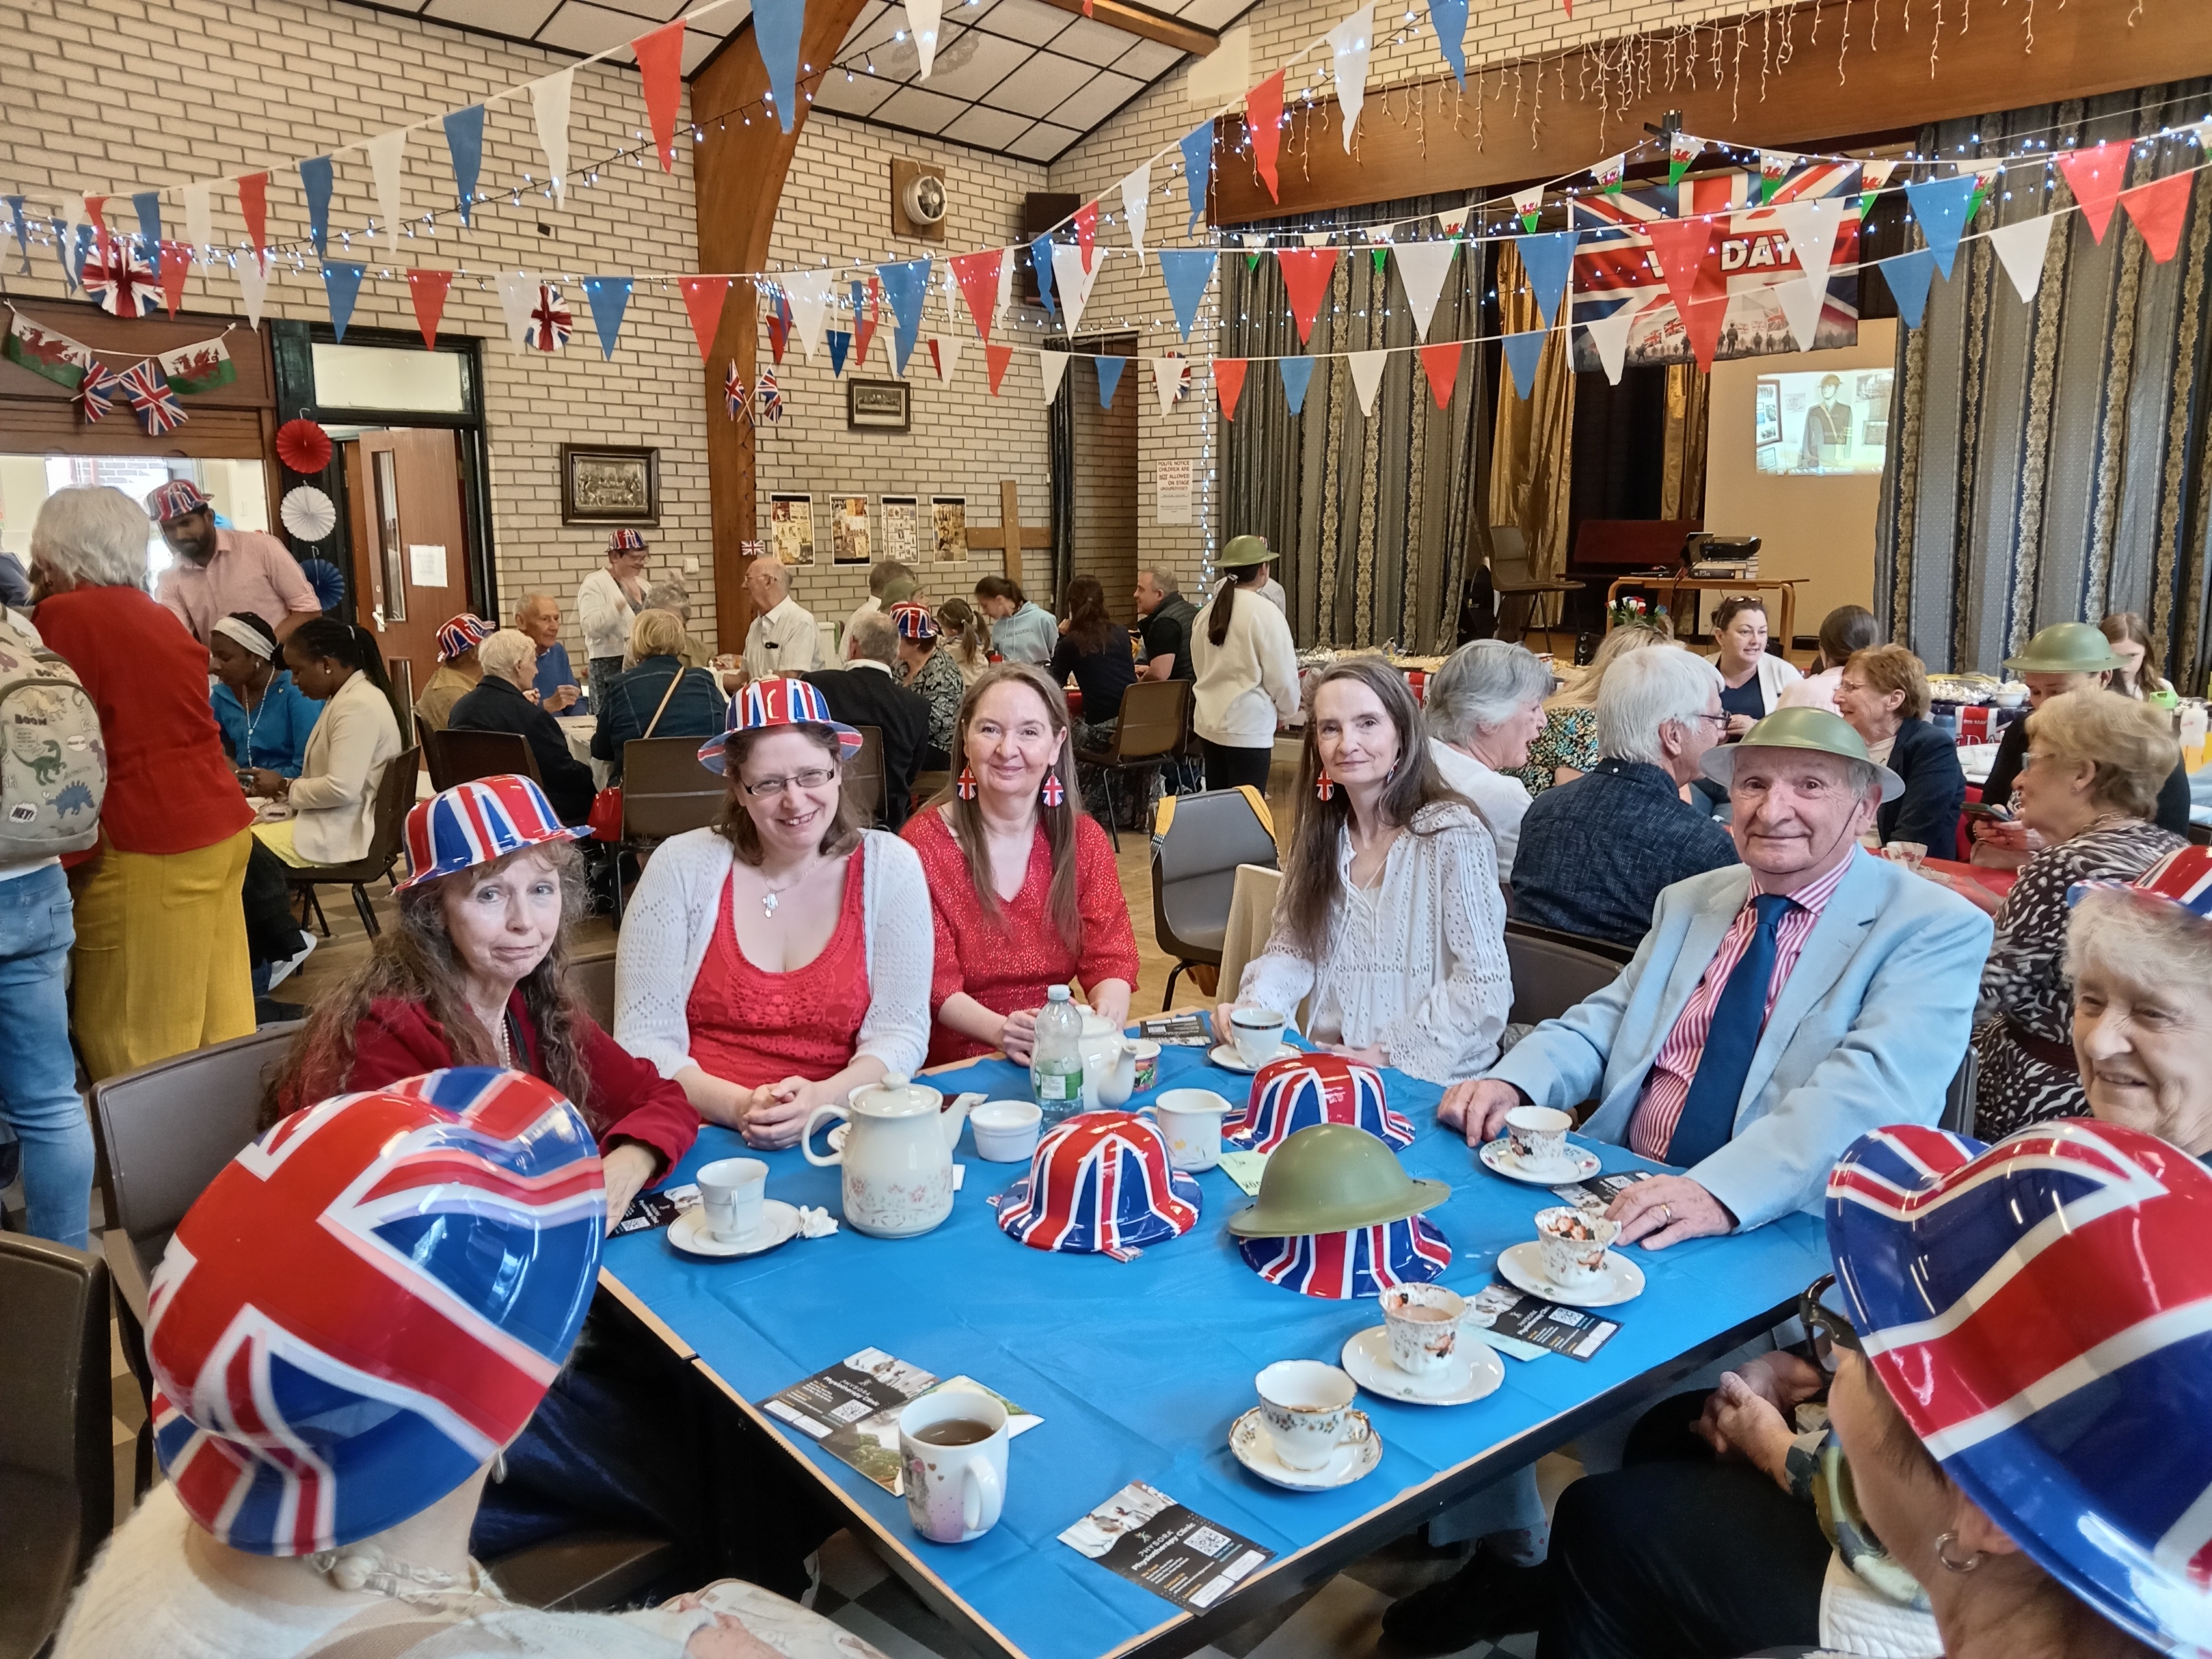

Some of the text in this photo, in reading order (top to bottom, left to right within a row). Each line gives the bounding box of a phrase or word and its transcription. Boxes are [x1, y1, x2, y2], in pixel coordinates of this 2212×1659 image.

[1721, 235, 1794, 271] DAY
[1131, 1535, 1179, 1570] Physiotherapy
[1176, 1522, 1196, 1537] Clinic
[1138, 1529, 1174, 1557] PHYSORA
